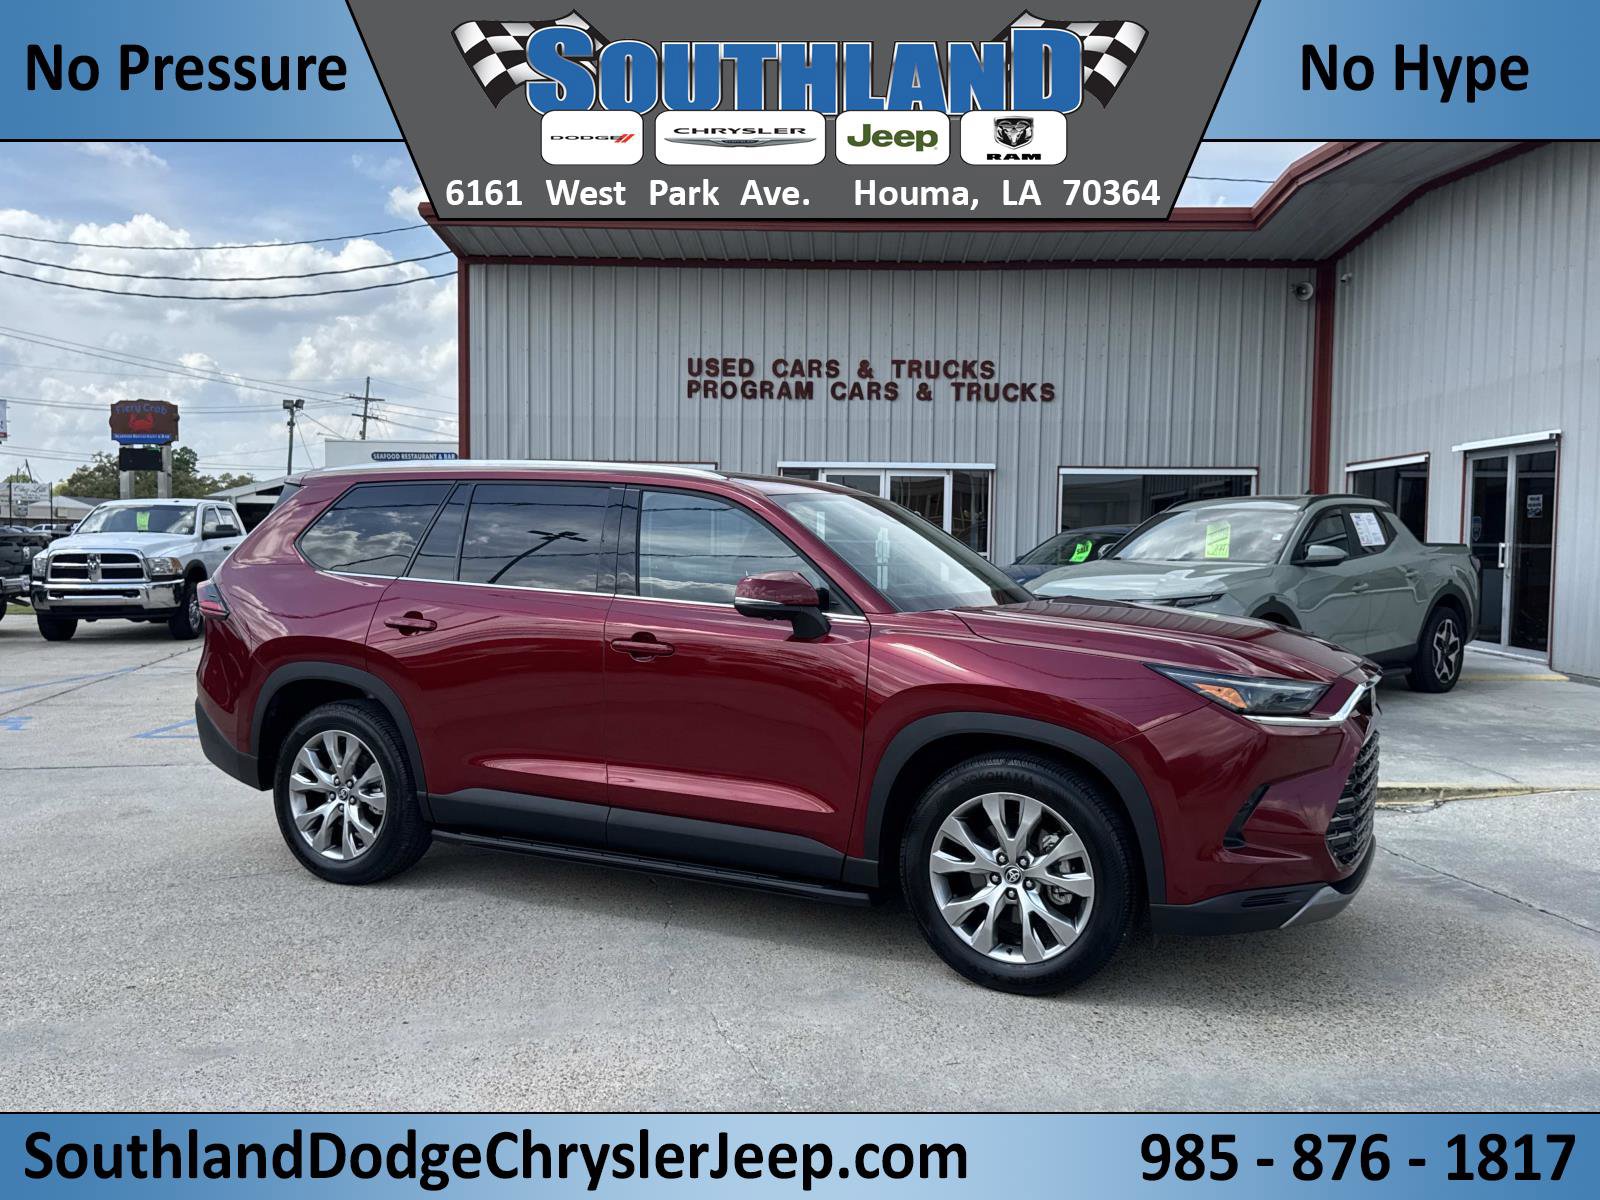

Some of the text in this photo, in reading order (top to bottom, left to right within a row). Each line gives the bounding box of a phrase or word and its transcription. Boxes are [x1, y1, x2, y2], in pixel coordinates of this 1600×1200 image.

[687, 357, 996, 380] USED CARS & TRUCKS
[687, 380, 1056, 403] PROGRAM CARS & TRUCKS
